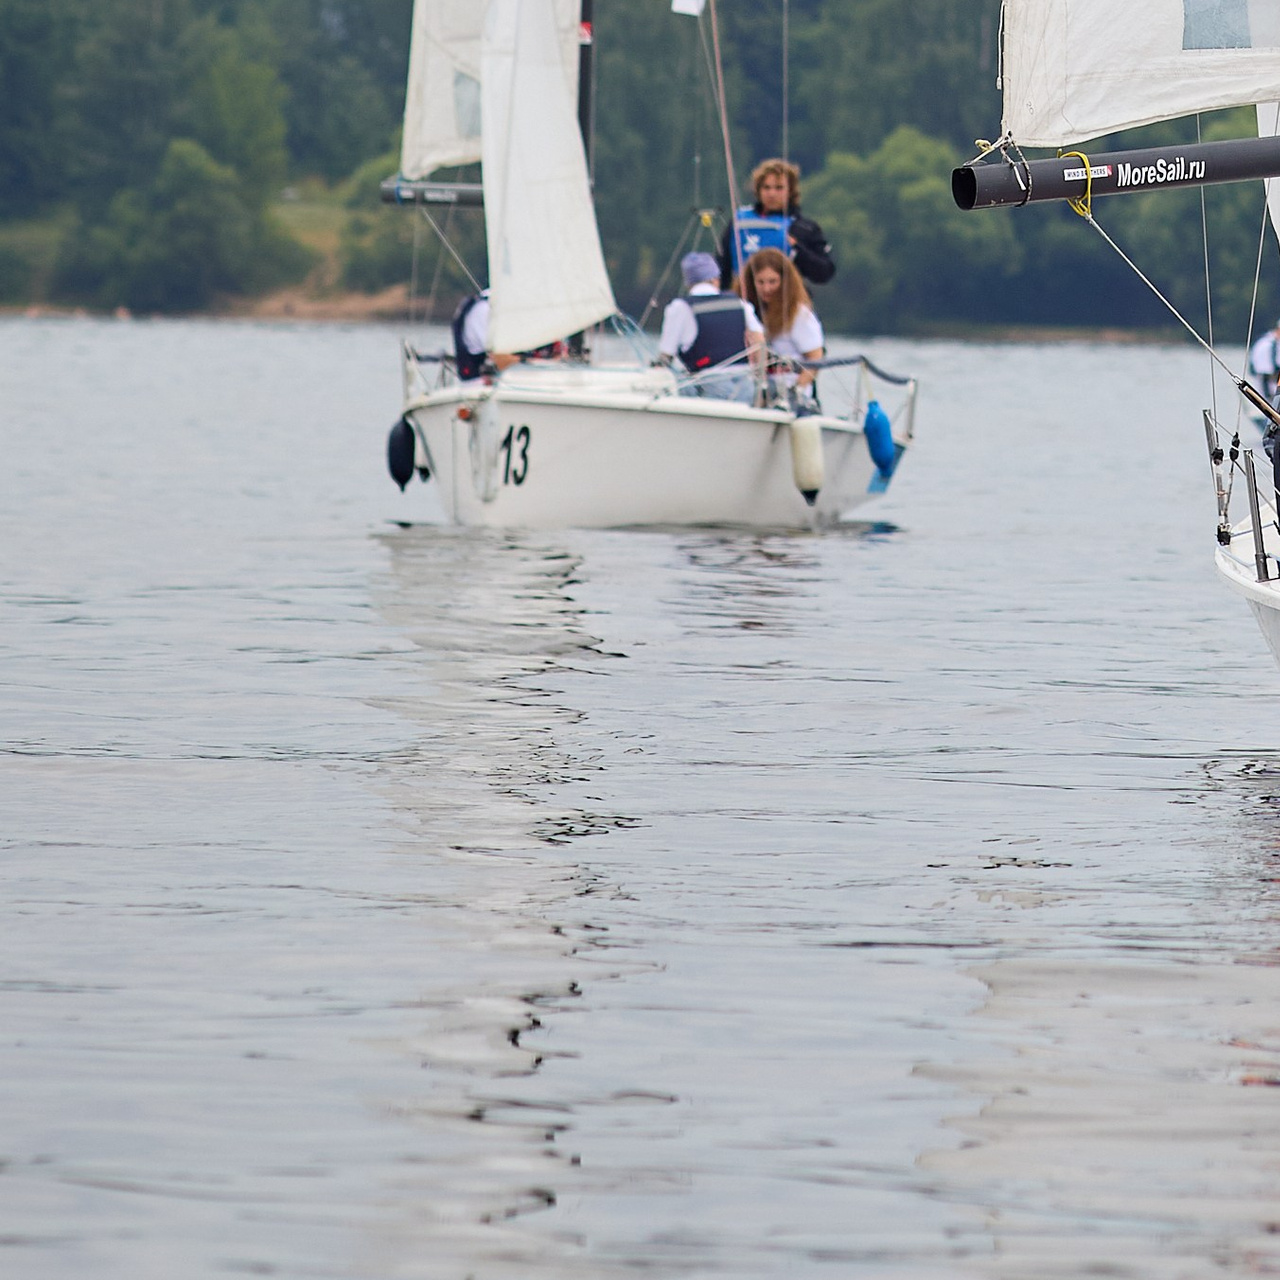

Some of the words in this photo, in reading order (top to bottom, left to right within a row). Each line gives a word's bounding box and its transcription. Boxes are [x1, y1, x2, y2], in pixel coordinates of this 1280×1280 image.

[1066, 170, 1080, 178] WIND
[1081, 167, 1106, 177] BRTHERS
[1117, 157, 1206, 187] MoreSail.ru
[500, 424, 530, 486] 13
